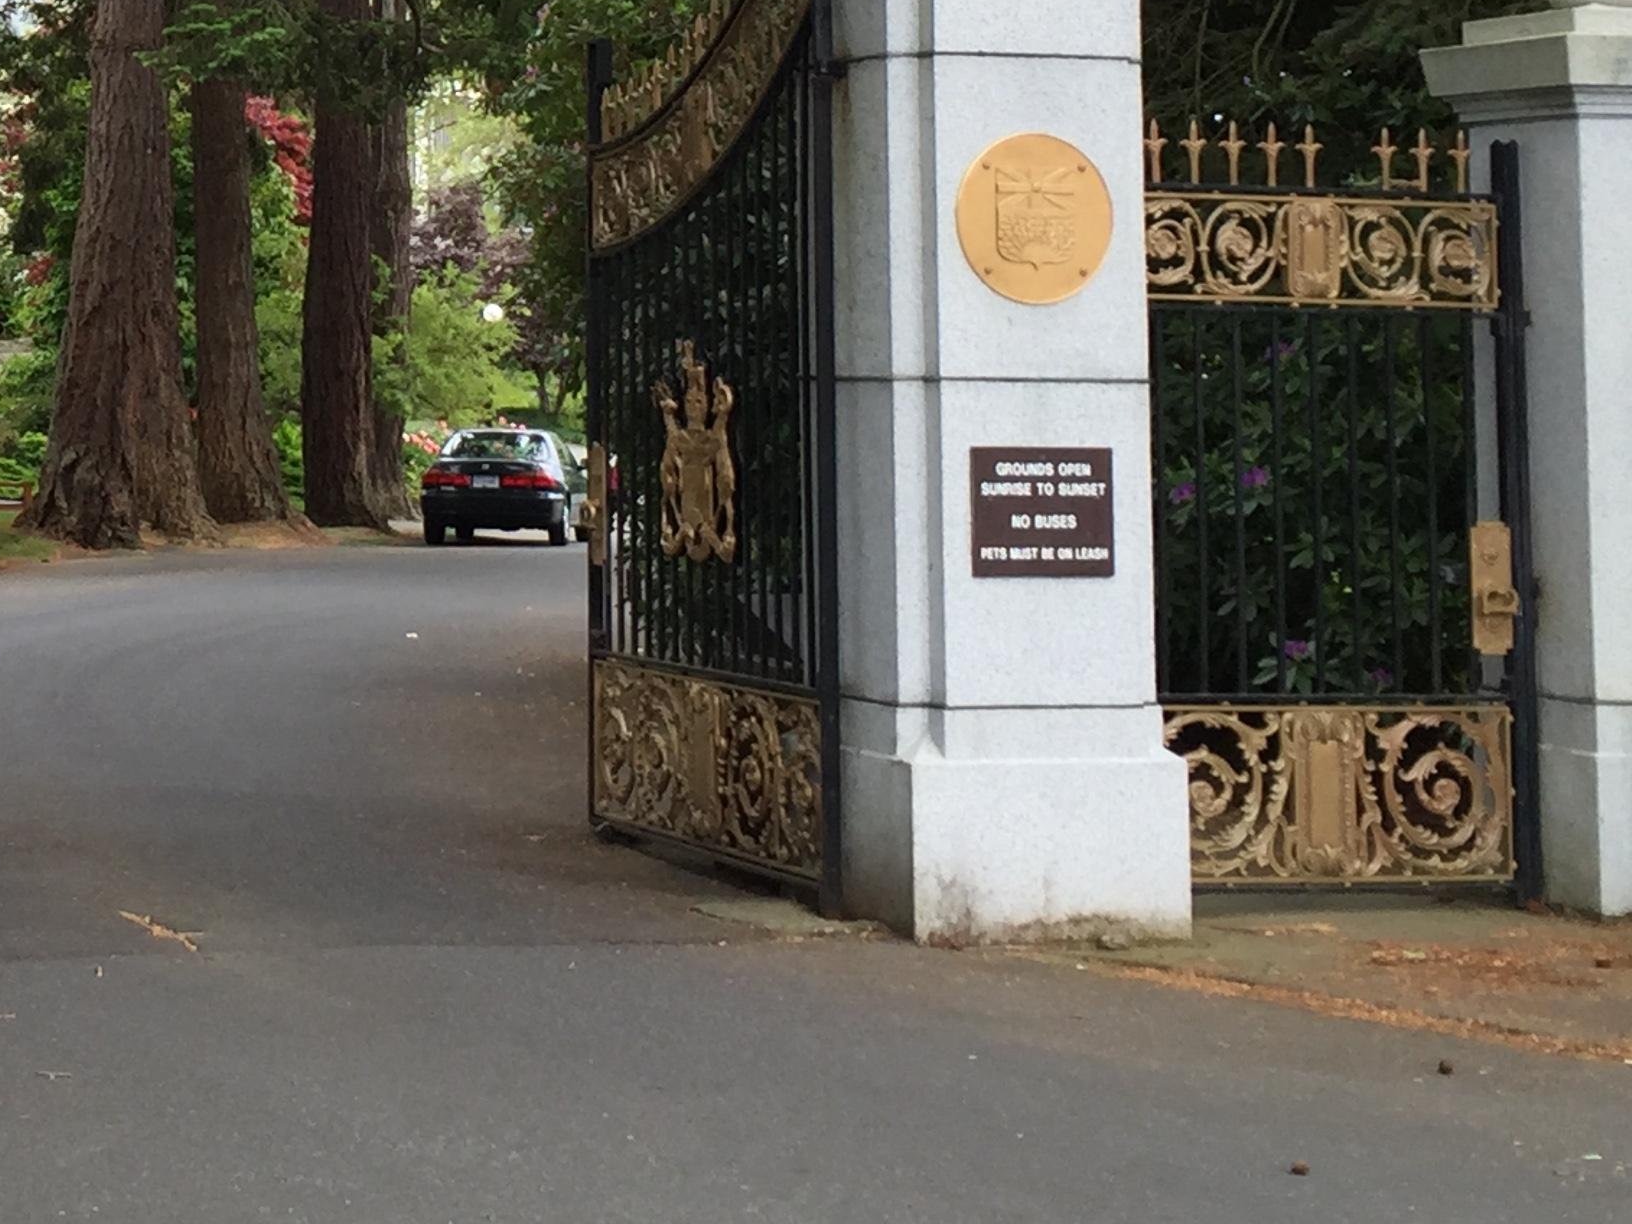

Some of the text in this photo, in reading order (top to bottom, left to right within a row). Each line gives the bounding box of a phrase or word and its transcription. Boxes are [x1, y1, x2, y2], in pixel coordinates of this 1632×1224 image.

[995, 462, 1091, 476] GROUNDS OPEN
[980, 482, 1106, 496] SUNRISE TO SUNSET
[1011, 514, 1078, 529] NO BUSES
[980, 547, 1109, 560] PETS MUST BE ON LEASH
